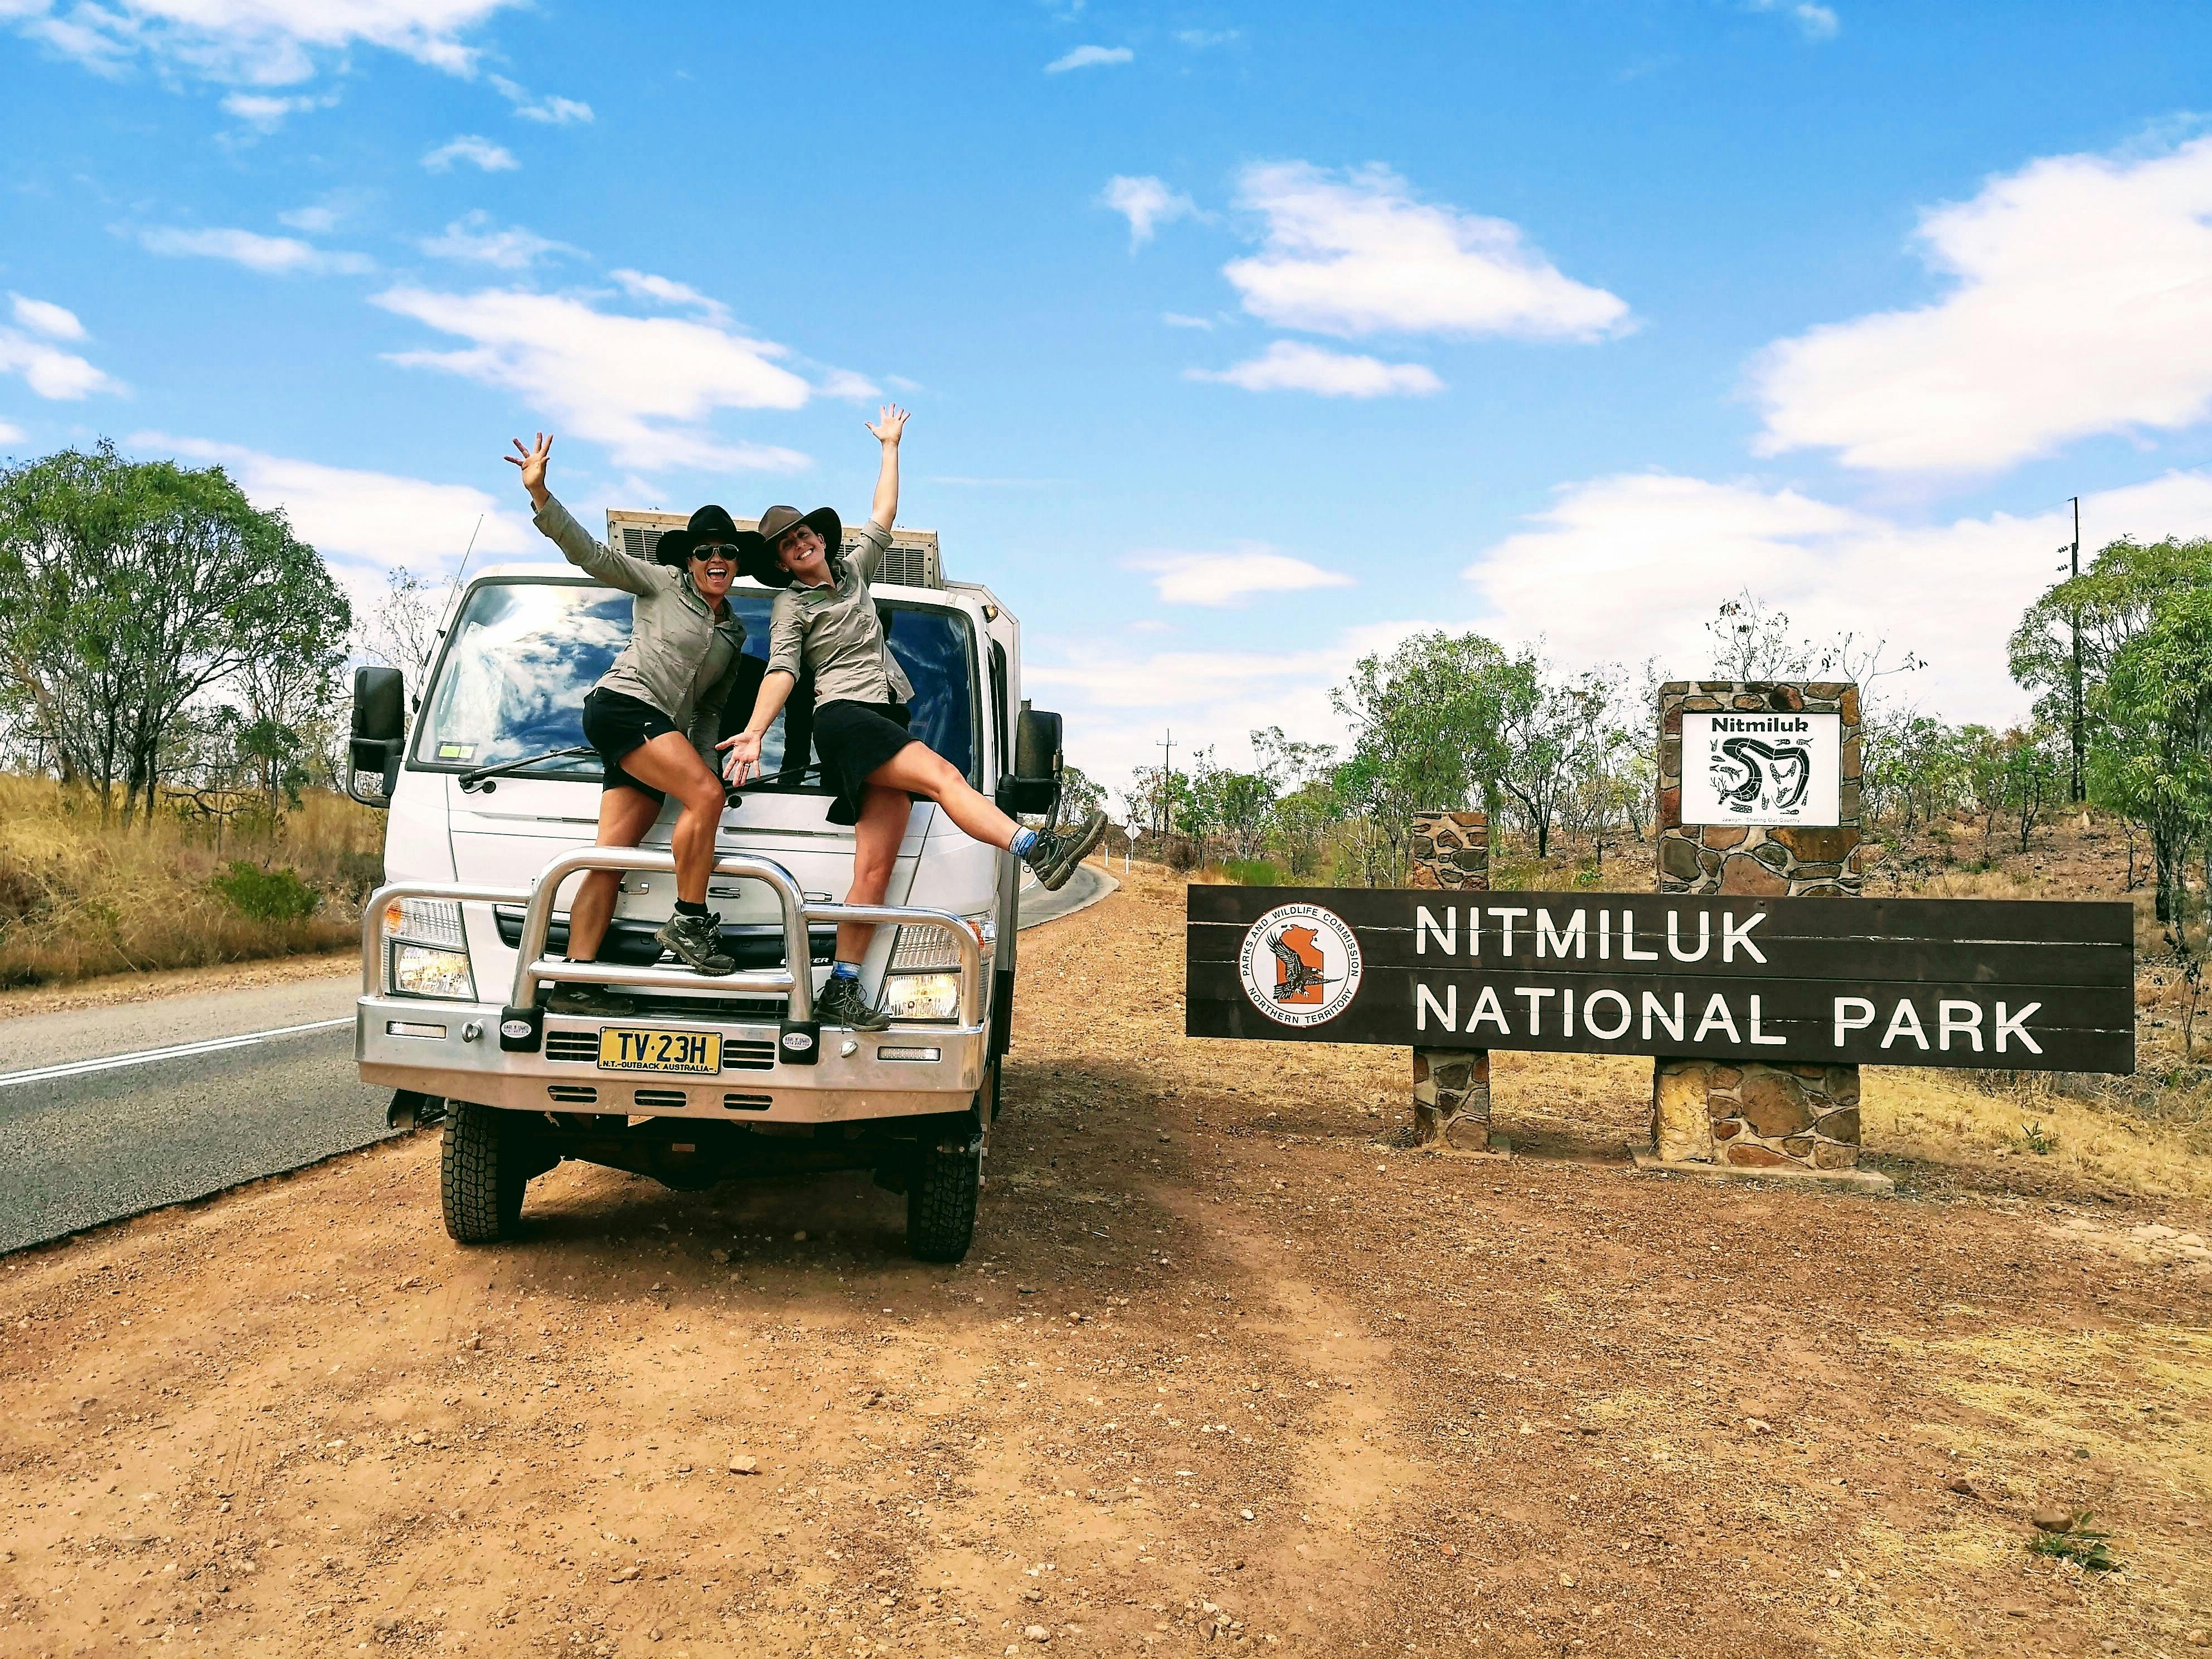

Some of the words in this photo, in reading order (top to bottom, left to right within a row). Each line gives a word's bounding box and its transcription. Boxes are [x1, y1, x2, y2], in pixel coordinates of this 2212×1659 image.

[1712, 717, 1808, 732] Nitmiluk
[1243, 940, 1253, 976] PARKS
[1251, 919, 1268, 939] AND
[1272, 906, 1318, 919] WILDLIFE
[1323, 913, 1359, 977] COMMISSION
[1417, 906, 1767, 964] NITMILUK
[1248, 987, 1299, 1023] NORTHERN
[1305, 988, 1353, 1023] TERRITORY
[1417, 983, 1787, 1045] NATIONAL
[1834, 996, 2043, 1054] PARK
